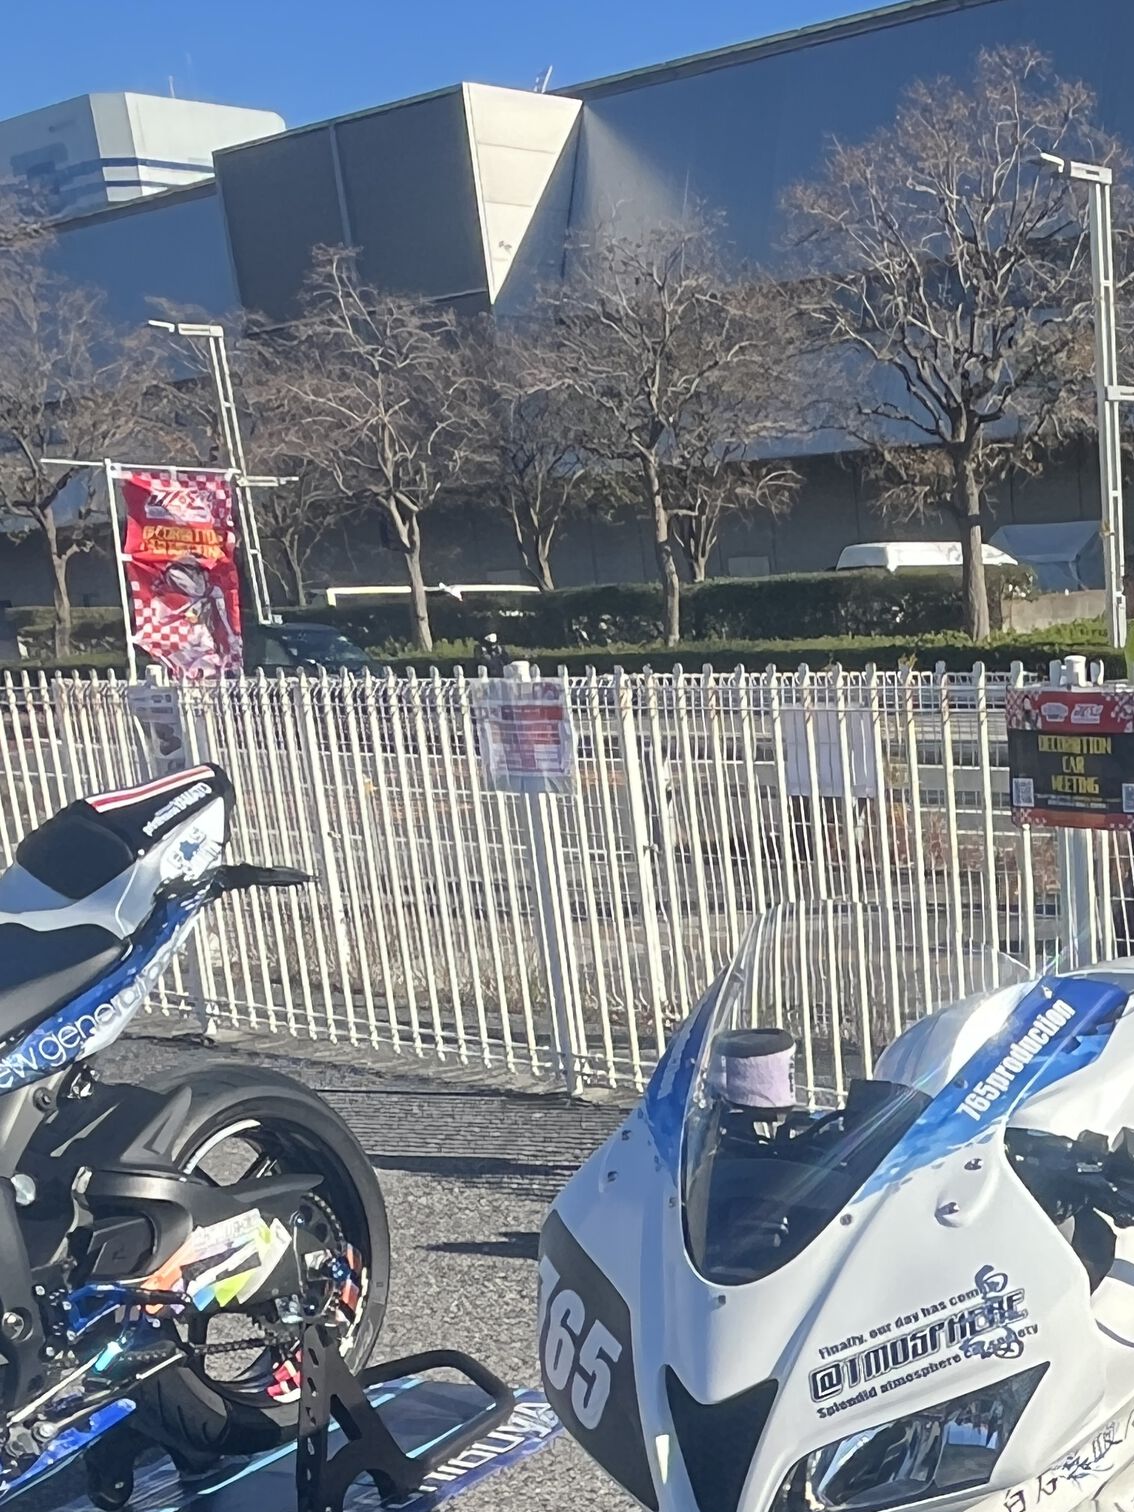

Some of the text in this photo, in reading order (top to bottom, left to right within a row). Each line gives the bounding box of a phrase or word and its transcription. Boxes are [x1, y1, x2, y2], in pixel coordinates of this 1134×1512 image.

[1052, 775, 1099, 794] MEETING
[1062, 756, 1085, 774] CAR
[956, 998, 1076, 1122] 765production
[539, 1254, 622, 1430] 765
[870, 1324, 892, 1339] our
[895, 1310, 919, 1328] day
[922, 1301, 947, 1320] has
[816, 1387, 878, 1419] Splendid
[881, 1351, 961, 1394] atmosphere
